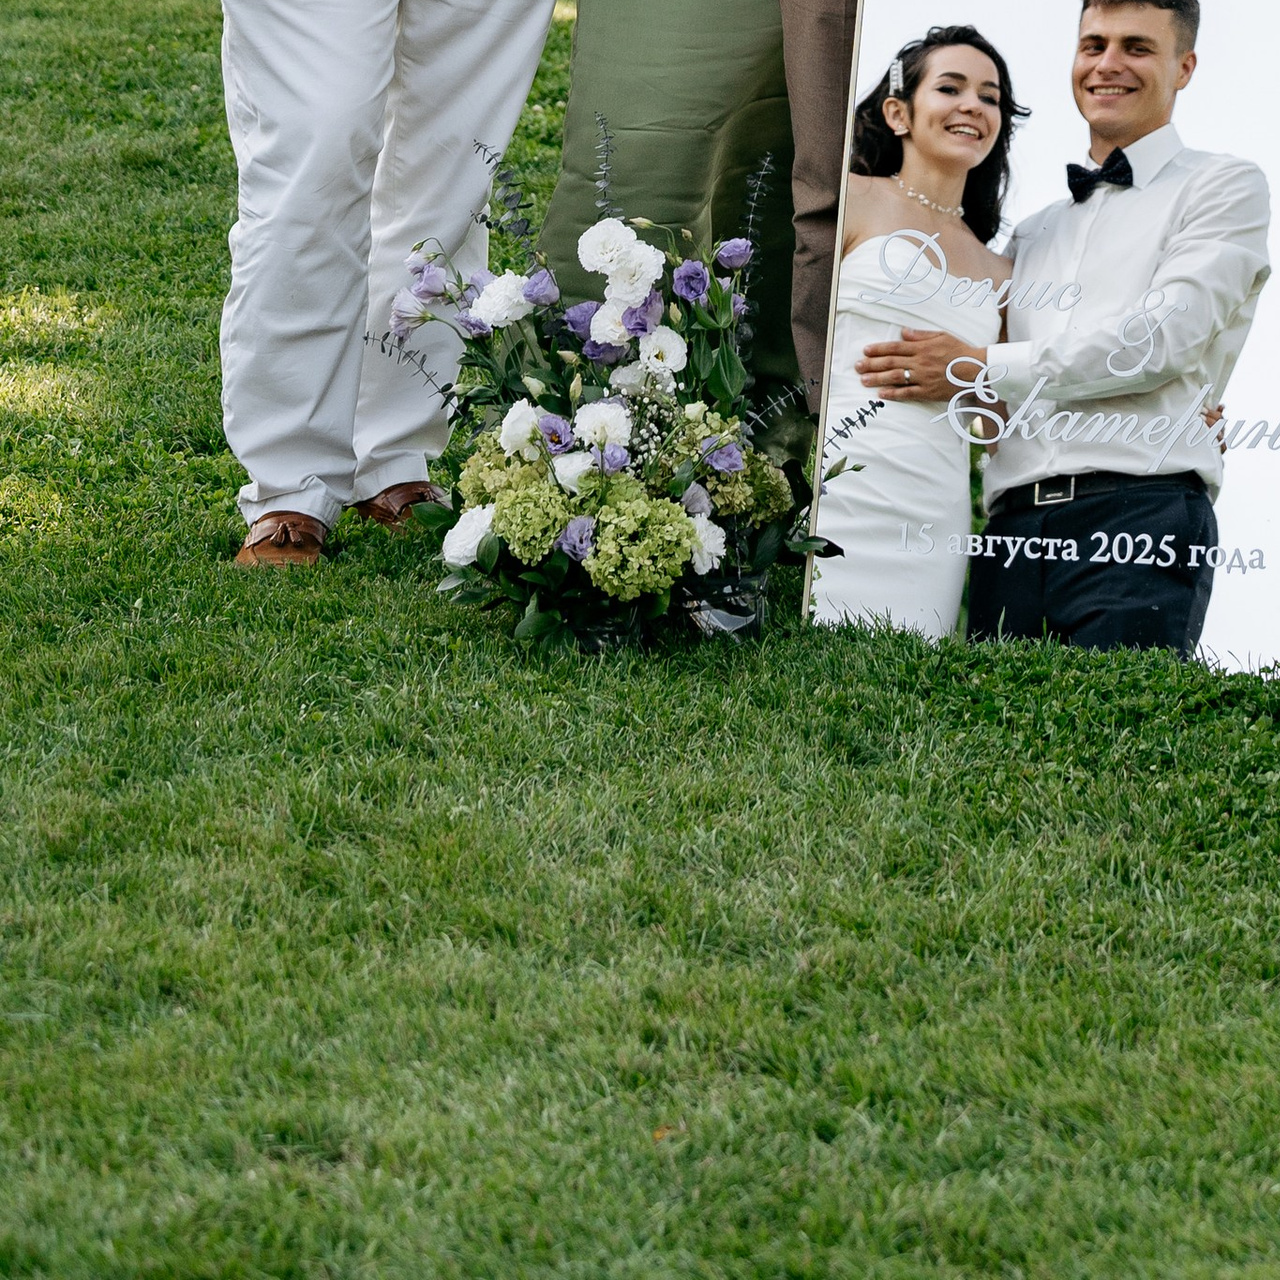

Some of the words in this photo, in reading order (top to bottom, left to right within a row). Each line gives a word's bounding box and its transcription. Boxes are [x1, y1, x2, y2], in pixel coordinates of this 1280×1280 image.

[858, 228, 1085, 311] Денис
[1107, 289, 1190, 377] &
[895, 521, 936, 556] 15
[947, 532, 1080, 569] августа
[1089, 531, 1177, 568] 2025
[1187, 542, 1267, 575] года
